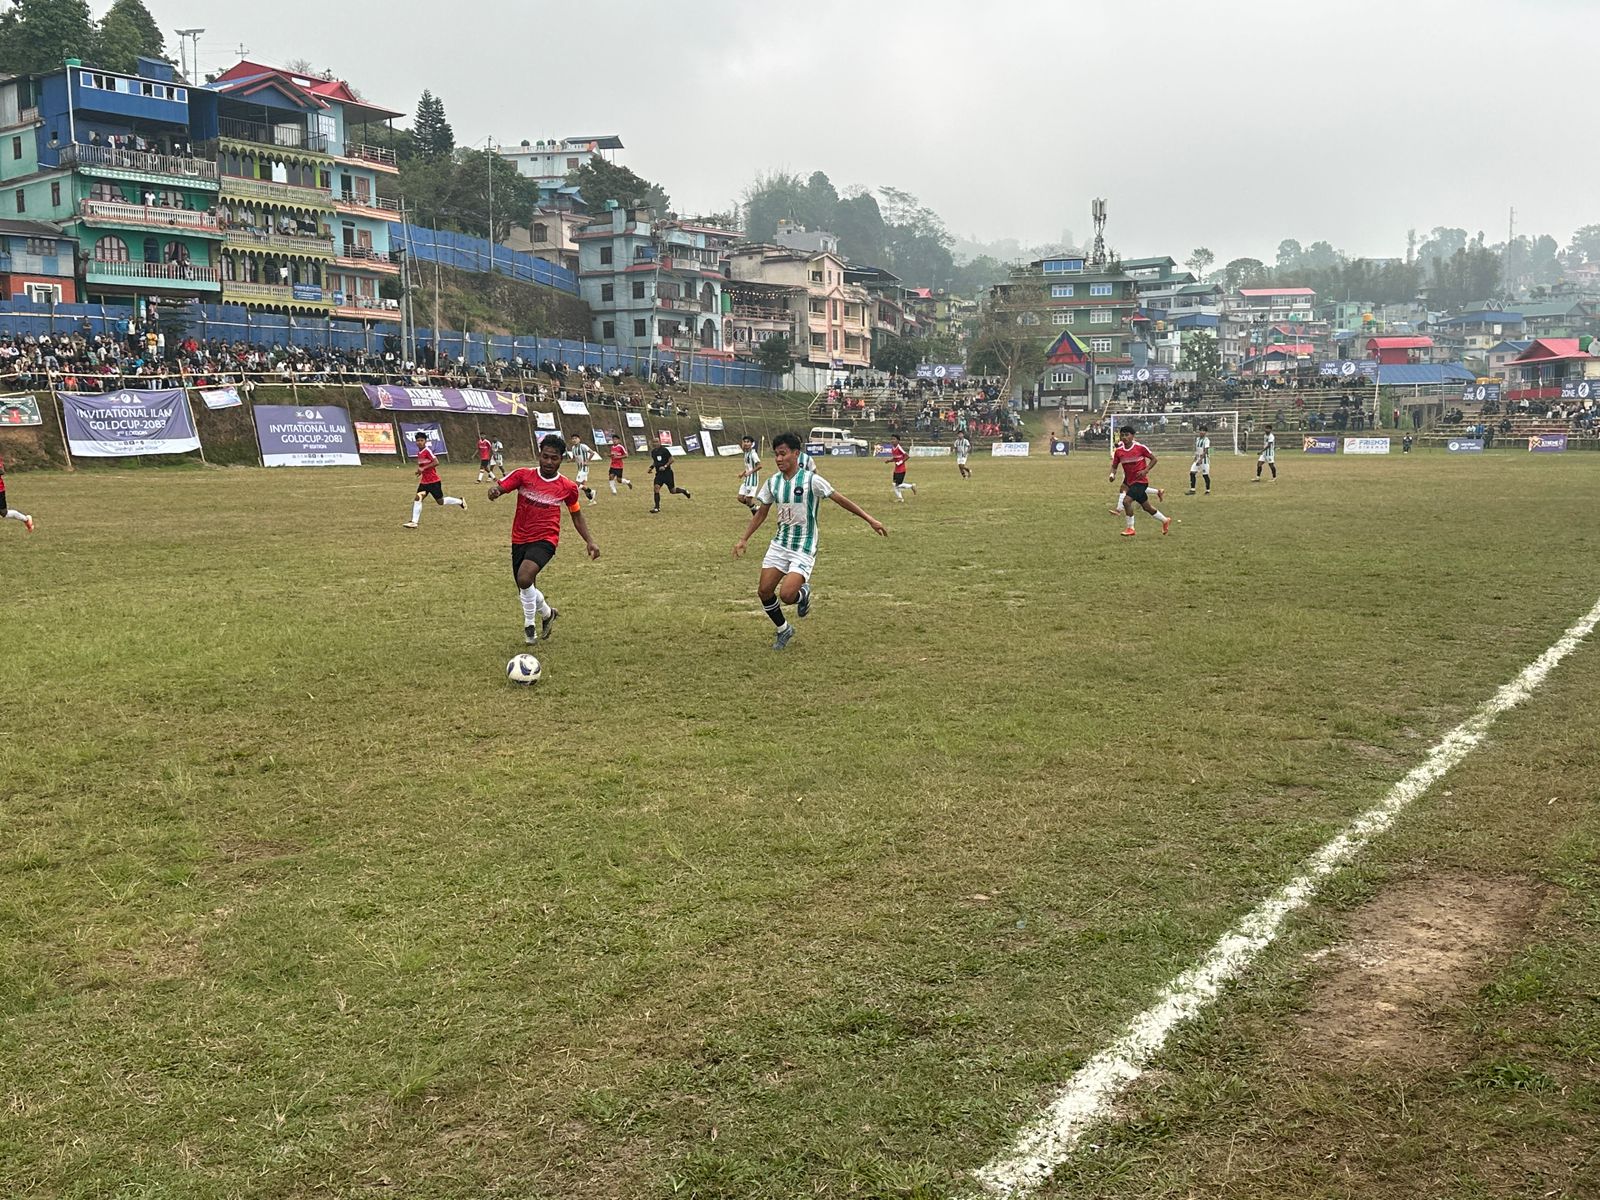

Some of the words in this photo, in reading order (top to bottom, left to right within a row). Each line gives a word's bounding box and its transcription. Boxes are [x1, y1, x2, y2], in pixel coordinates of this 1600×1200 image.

[1117, 374, 1134, 382] ZONE
[403, 388, 446, 401] XTREME
[1561, 389, 1576, 397] ZONE
[76, 408, 149, 419] INVITATIONAL
[150, 408, 173, 418] ILAM
[89, 420, 166, 431] GOLDCUP-2083
[269, 424, 328, 433] INVITATIONAL
[329, 424, 346, 433] ILAM
[281, 434, 343, 443] GOLDCUP-2083
